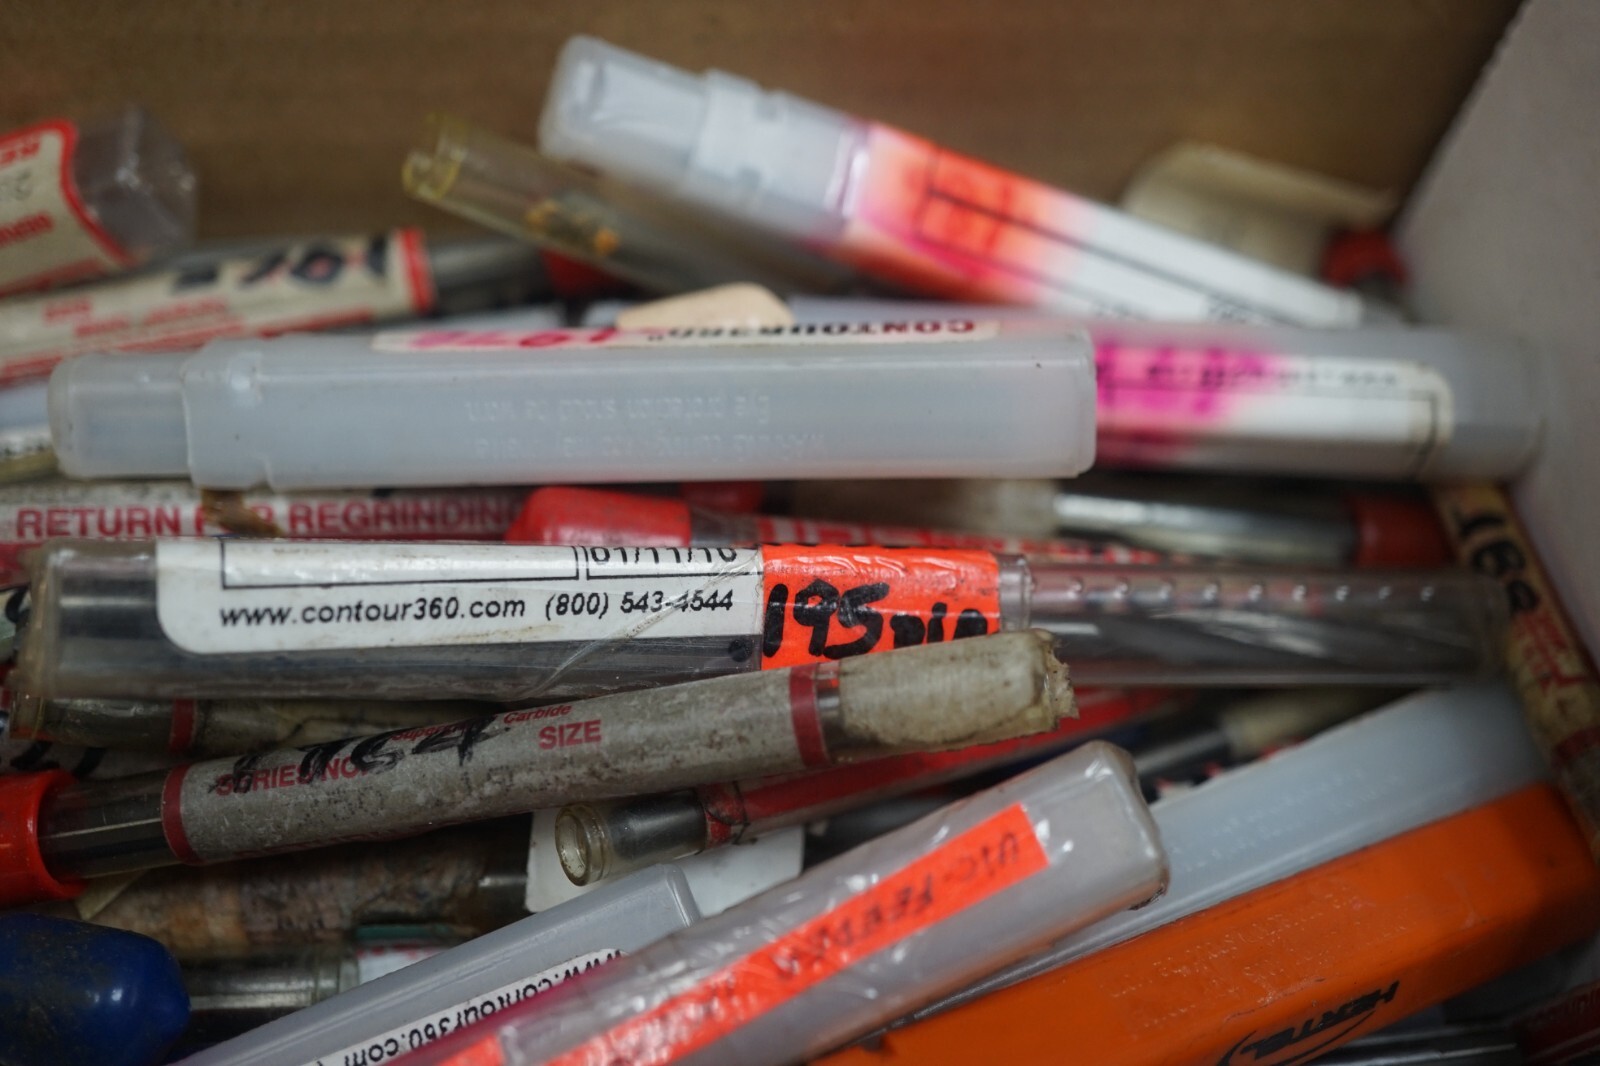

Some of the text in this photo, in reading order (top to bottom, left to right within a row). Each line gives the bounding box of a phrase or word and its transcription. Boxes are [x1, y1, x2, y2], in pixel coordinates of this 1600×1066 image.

[15, 506, 182, 537] RETURN
[220, 588, 734, 627] www.contour360.com (800) 543-4544
[503, 704, 573, 725] Carbide
[538, 719, 602, 751] SIZE
[1239, 979, 1401, 1062] HERTEL
